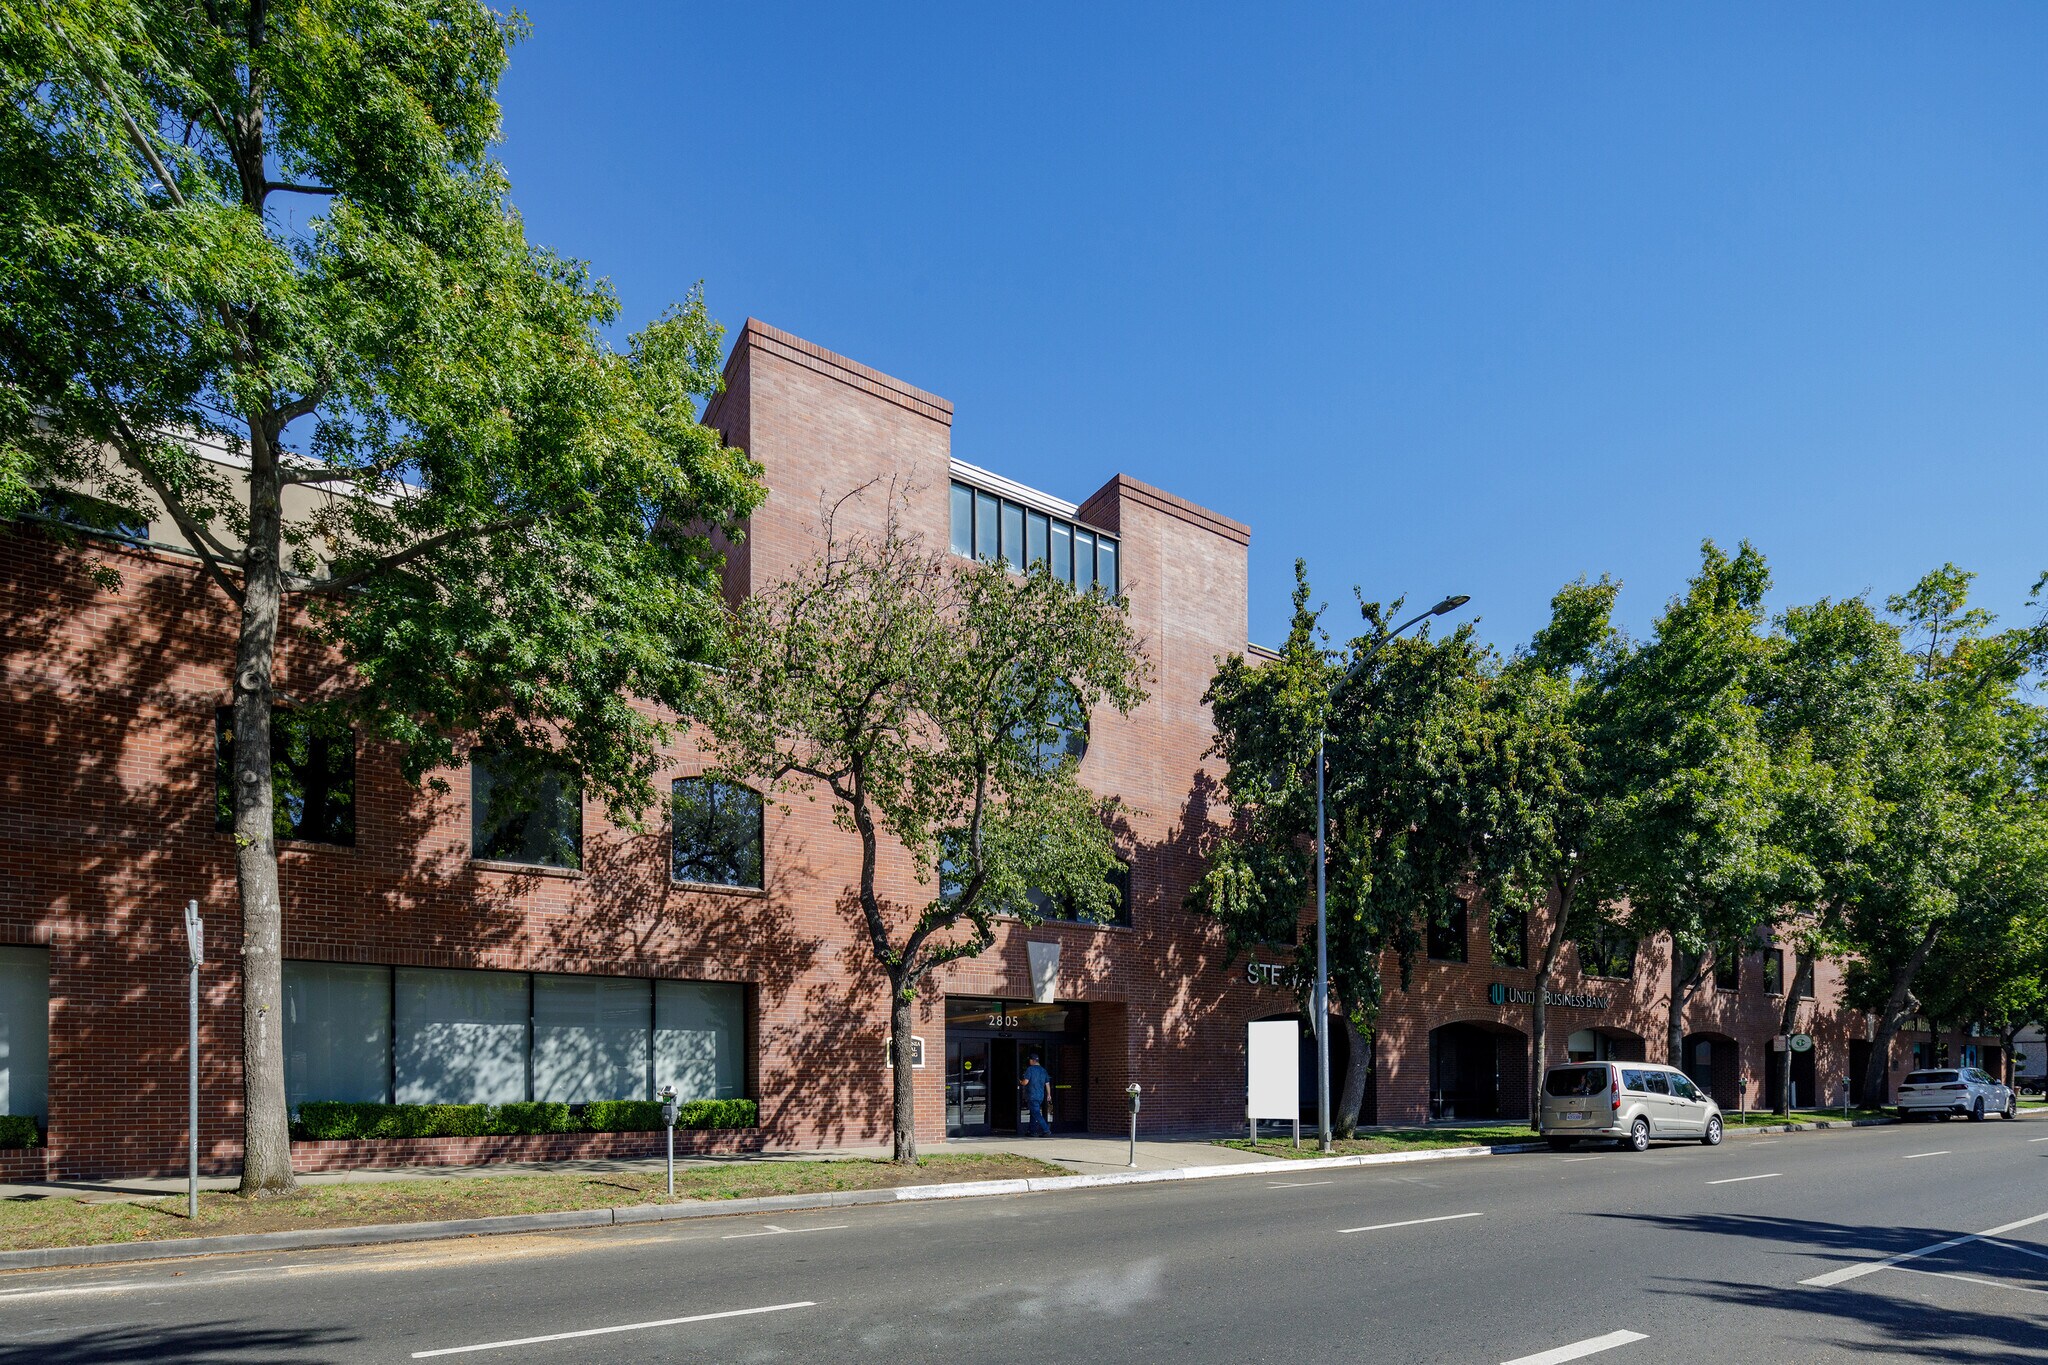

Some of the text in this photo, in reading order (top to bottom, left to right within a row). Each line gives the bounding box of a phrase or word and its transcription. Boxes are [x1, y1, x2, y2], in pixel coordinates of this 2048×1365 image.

[1545, 991, 1585, 1008] BUSINESS
[1586, 995, 1610, 1009] BANK
[989, 1015, 1018, 1026] 2805
